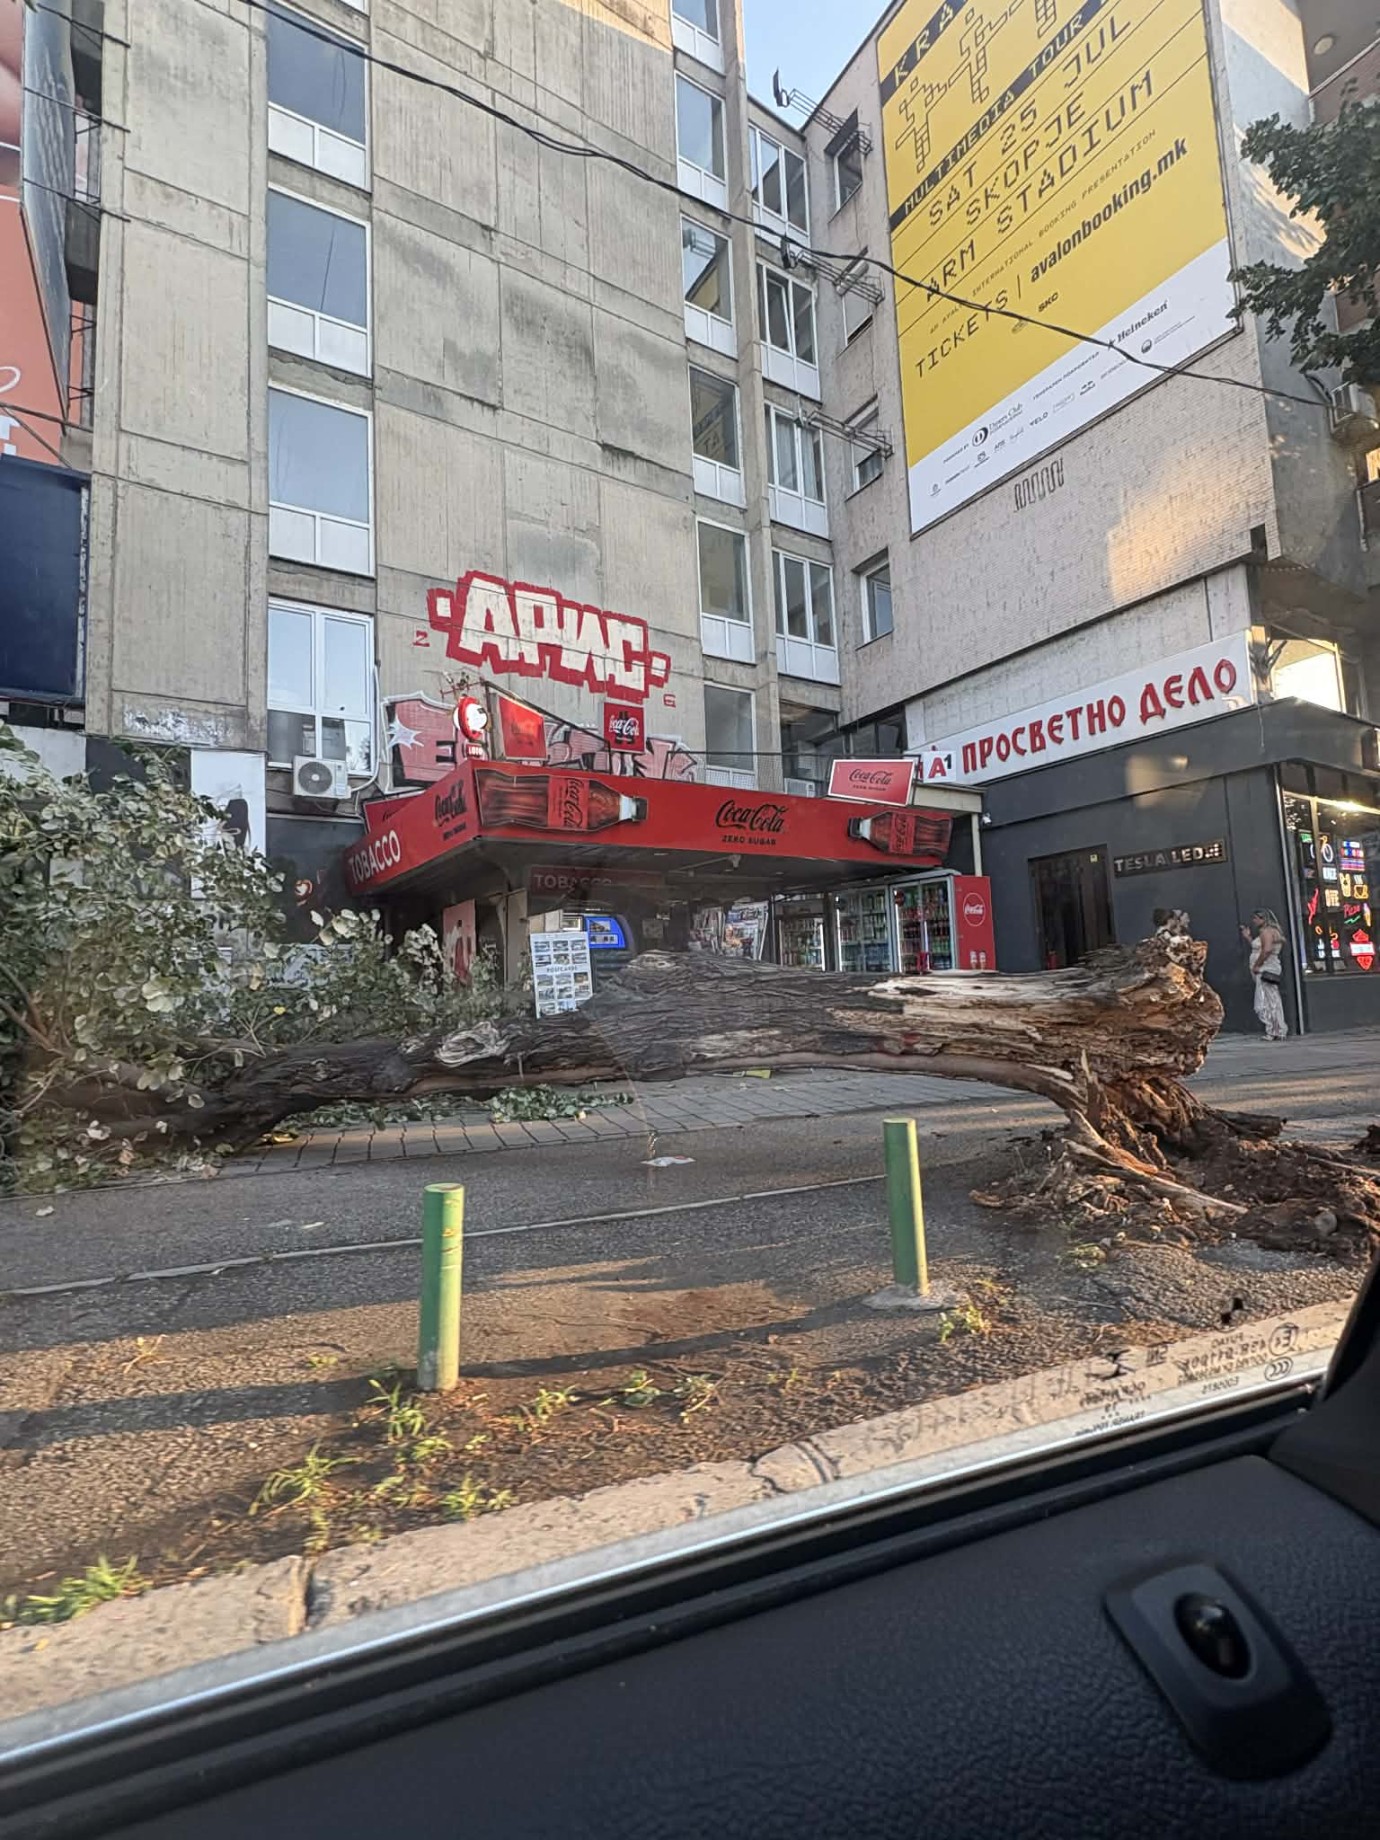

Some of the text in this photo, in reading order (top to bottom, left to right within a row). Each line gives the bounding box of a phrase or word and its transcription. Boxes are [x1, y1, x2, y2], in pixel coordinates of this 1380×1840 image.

[904, 13, 1084, 216] MULTIMEDIA TOUR
[928, 15, 1132, 227] SAT 25 JUL
[926, 69, 1154, 303] ARM STADIUM
[965, 91, 1085, 226] SKOPJE
[972, 240, 1034, 297] INTERNATIONAL
[1038, 200, 1078, 238] BOOKING
[1081, 128, 1157, 200] PRESENTATION
[914, 288, 1009, 378] TICKETS
[1030, 135, 1189, 284] avalonbooking.mk
[1116, 300, 1168, 344] Heineken
[961, 657, 1238, 775] ПРОСВЕТНО ДЕЛО
[849, 769, 894, 785] Coca-Cola
[928, 753, 953, 779] A1
[348, 829, 401, 885] TOBACCO
[715, 799, 789, 833] Coca-Cola
[722, 835, 776, 845] ZERO SUGAR
[1114, 847, 1204, 872] TESLA LED
